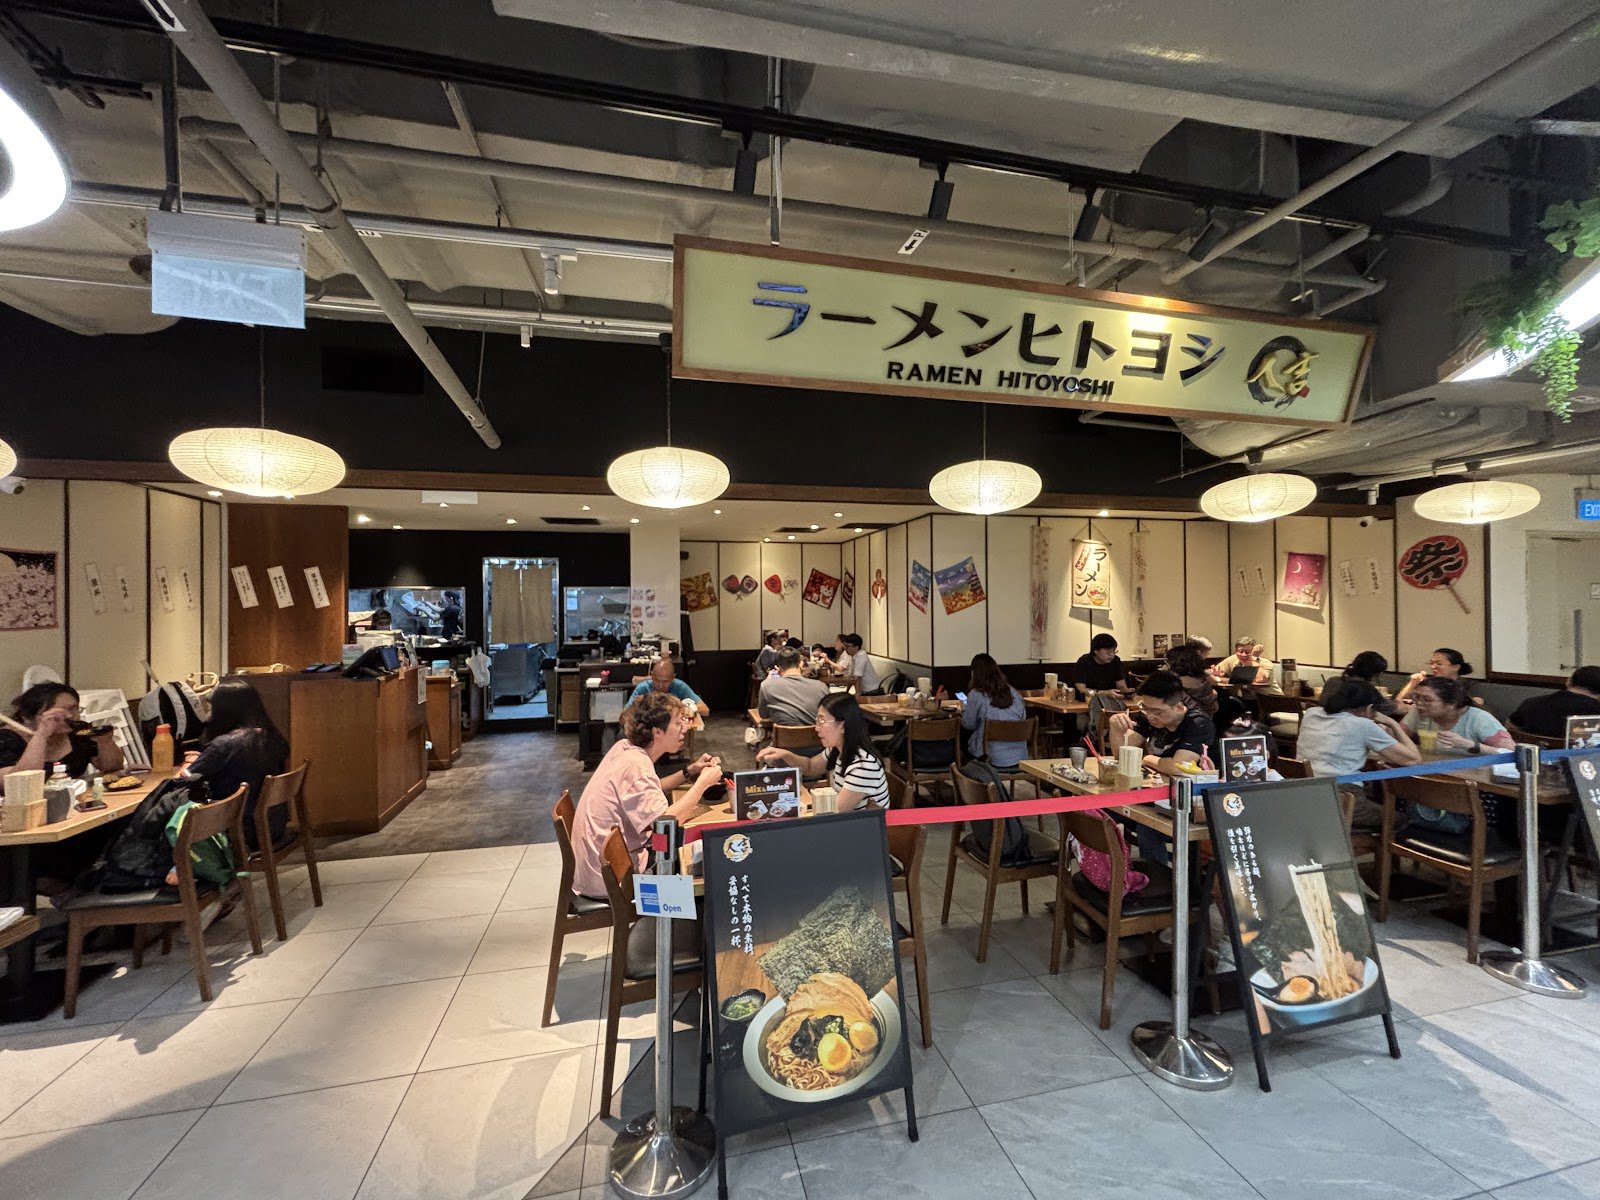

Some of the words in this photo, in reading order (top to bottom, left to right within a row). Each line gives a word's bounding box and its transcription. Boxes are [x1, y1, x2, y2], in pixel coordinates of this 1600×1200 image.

[753, 281, 1226, 383] ラーメンヒトヨシ
[886, 361, 982, 386] RAMEN
[997, 370, 1115, 396] HITOYOSHI
[1075, 547, 1107, 597] ラーメン
[1402, 541, 1464, 585] 祭
[745, 784, 762, 794] Mix
[766, 784, 790, 792] Match
[663, 903, 682, 914] Open
